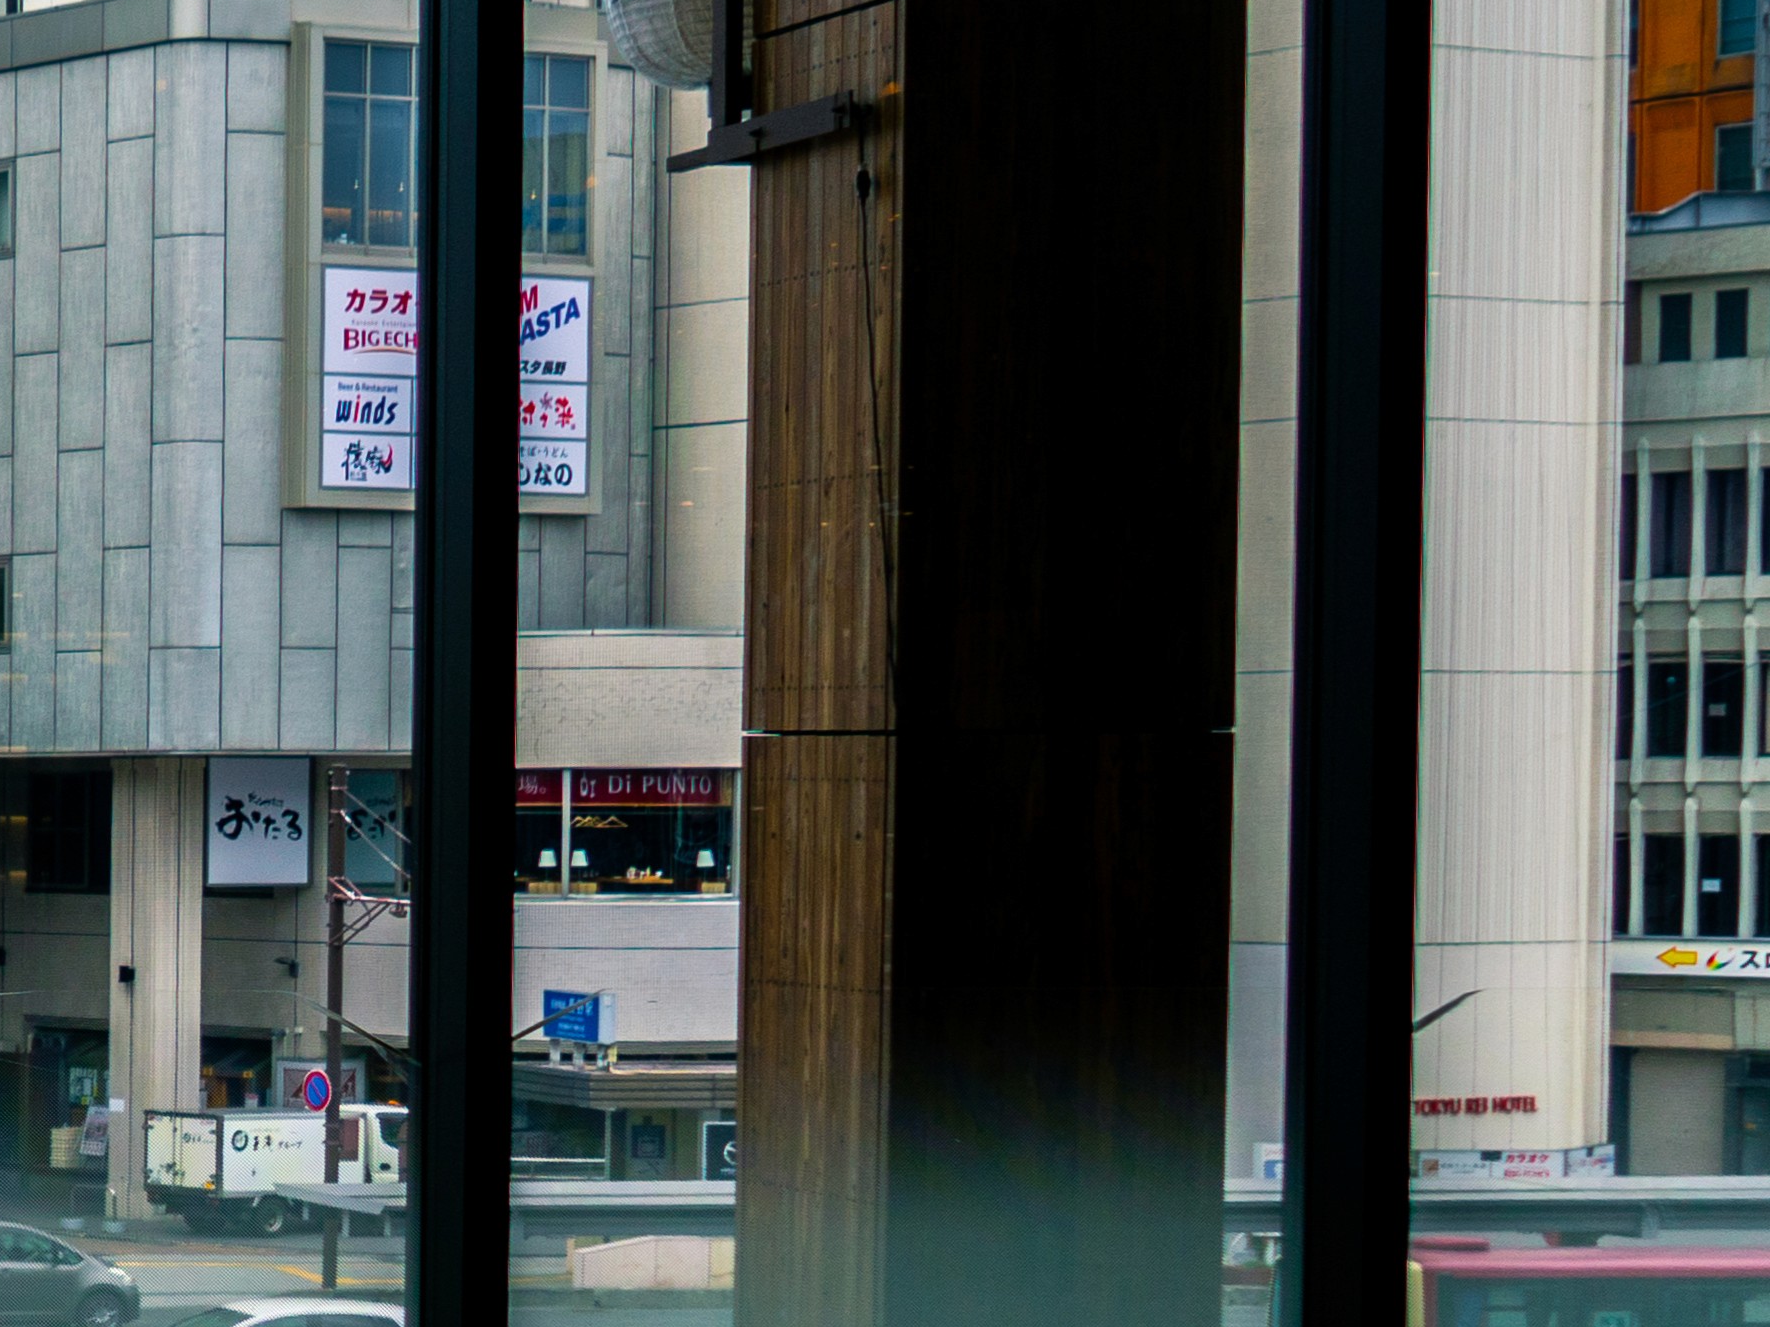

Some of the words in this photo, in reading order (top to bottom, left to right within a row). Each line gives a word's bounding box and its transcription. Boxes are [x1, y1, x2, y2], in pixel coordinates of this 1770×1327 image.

[344, 288, 416, 315] カラオ
[520, 284, 538, 315] M
[520, 297, 580, 347] ASTA
[343, 327, 380, 351] BIG
[384, 330, 418, 350] ECH
[520, 359, 567, 376] スタ長野
[335, 394, 399, 426] winds
[641, 773, 713, 795] PUNTO
[1491, 1095, 1538, 1115] HOTEL
